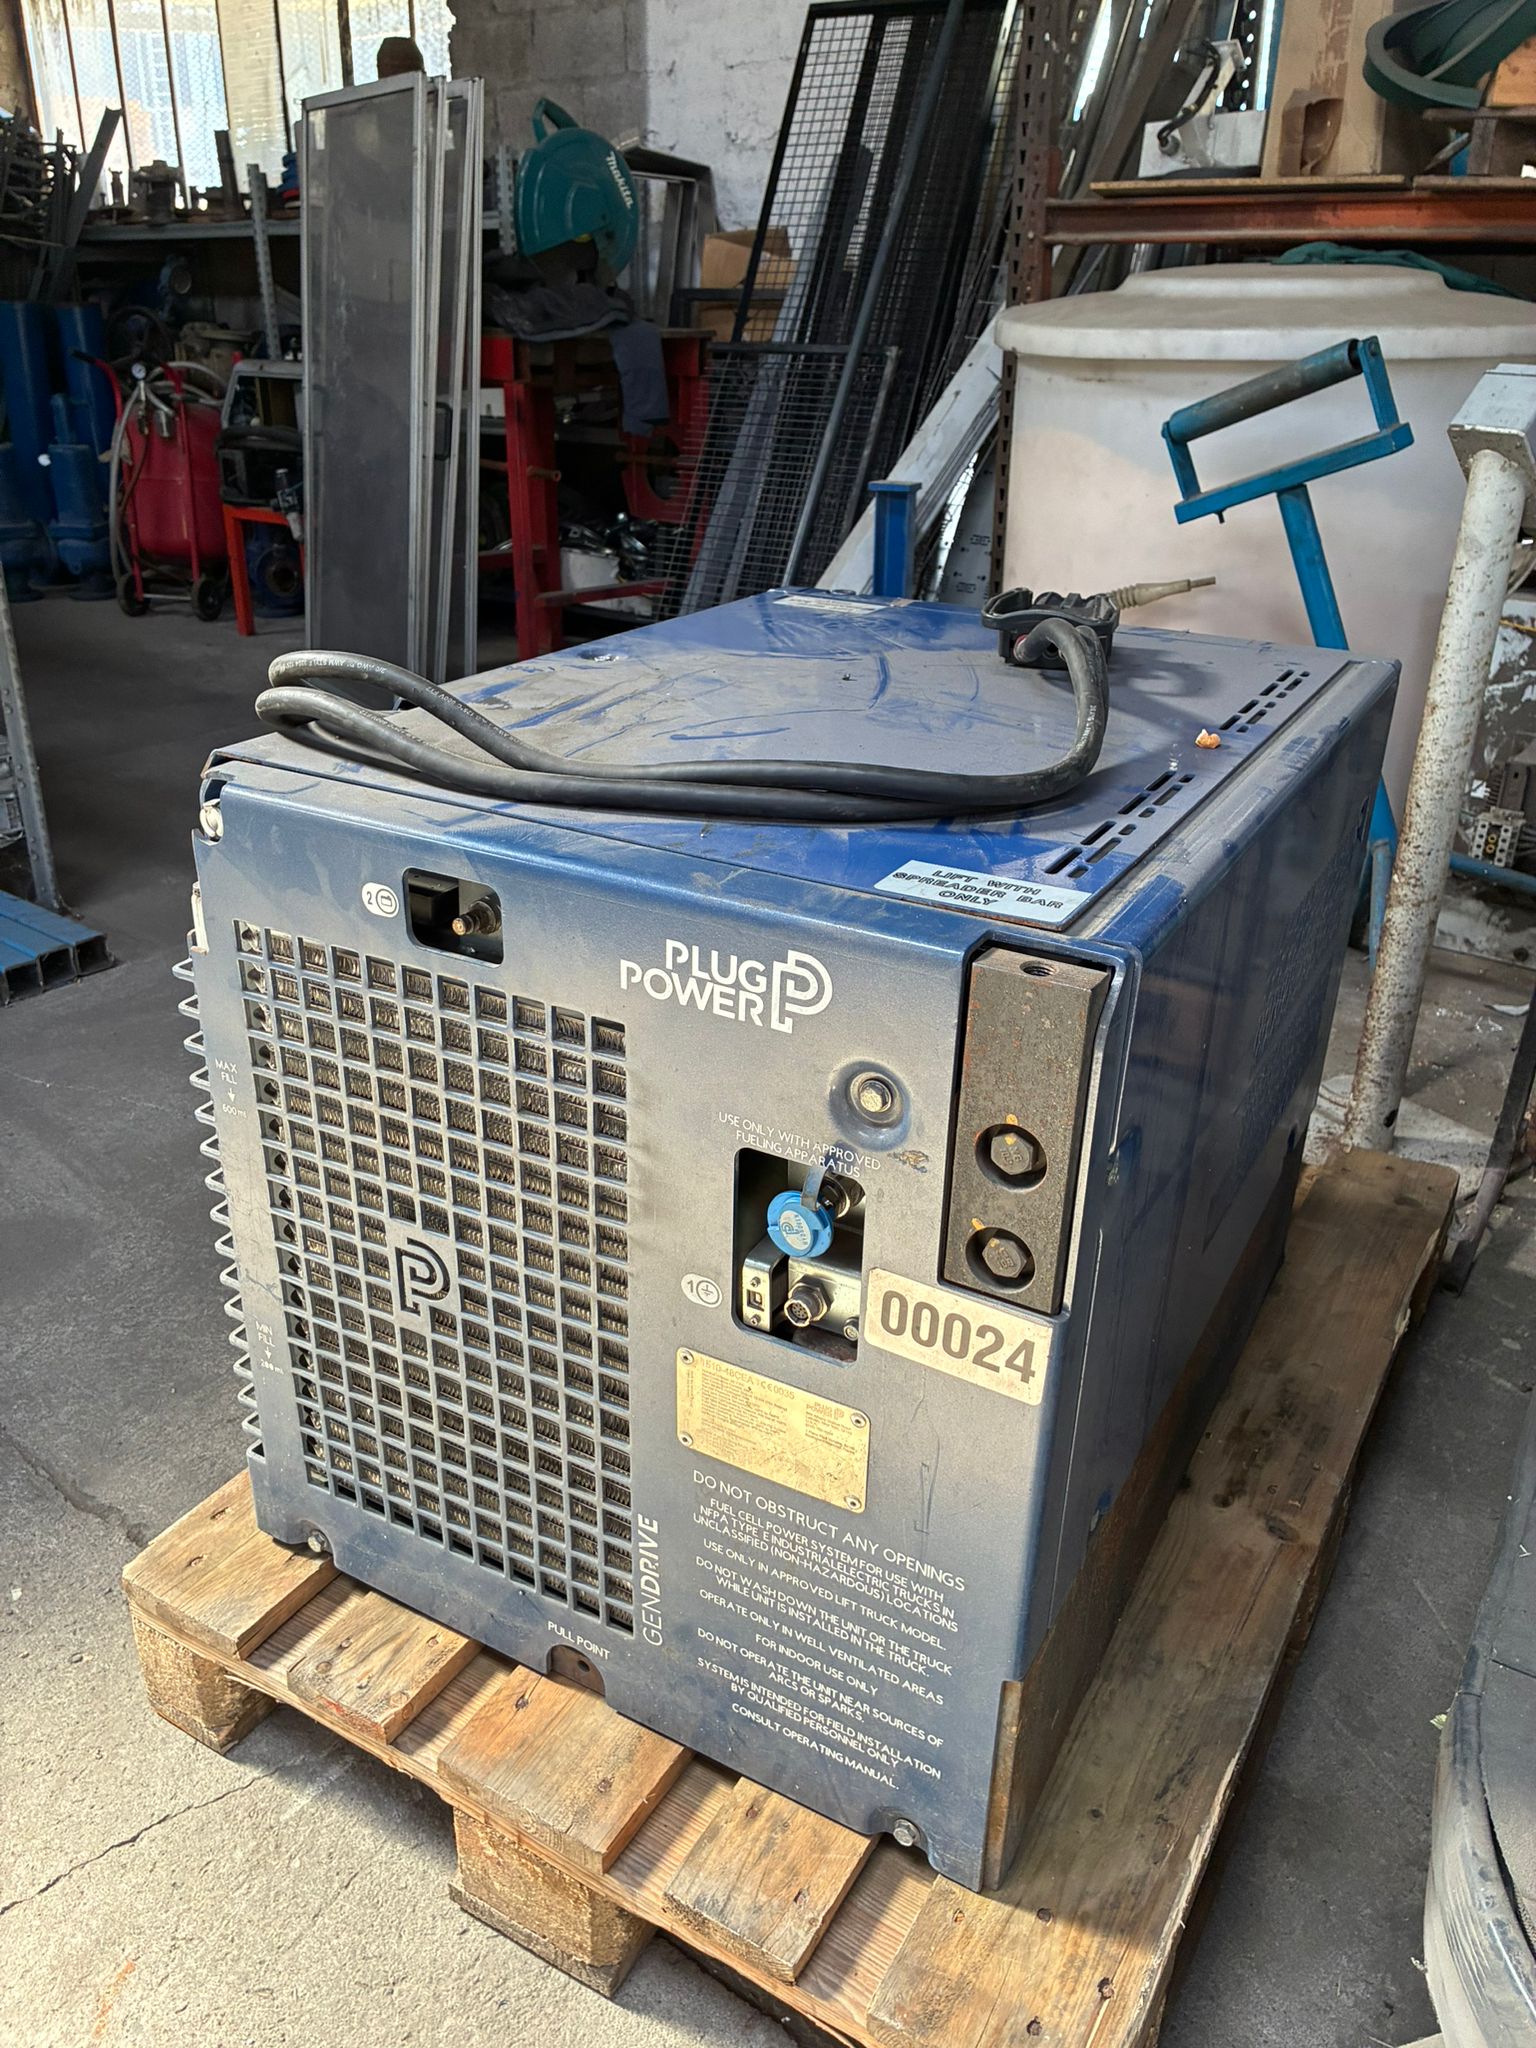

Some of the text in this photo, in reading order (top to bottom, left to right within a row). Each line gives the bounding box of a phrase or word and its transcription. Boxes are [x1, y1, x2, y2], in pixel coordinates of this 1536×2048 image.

[606, 150, 634, 209] Makita
[366, 890, 373, 905] 2
[892, 872, 1064, 908] SPREADER BAR
[932, 870, 1042, 895] LIFT WITH
[938, 890, 999, 906] ONLY
[620, 958, 764, 1027] POWER
[665, 938, 767, 994] PLUG
[215, 1058, 238, 1074] MAX
[221, 1072, 238, 1085] FILL
[718, 1112, 881, 1170] USE ONLY WITH APPROVED
[736, 1130, 860, 1178] FUELING APPARATUS
[687, 1280, 694, 1293] 1
[256, 1320, 272, 1336] MIN
[258, 1332, 276, 1348] FILL
[880, 1290, 1036, 1384] 00024
[694, 1470, 966, 1592] DO NOT OBSTRUCT ANY OPENINGS
[700, 1505, 728, 1524] NFPA
[731, 1518, 758, 1537] TYPE
[763, 1532, 769, 1542] E
[892, 1585, 940, 1613] TRUCKS
[942, 1606, 954, 1619] IN
[710, 1498, 944, 1602] FUEL CELL POWER SYSTEM FOR USE WITH
[638, 1513, 664, 1646] GENDRIVE
[694, 1512, 958, 1632] UNCLASSIFIED (NON-HAZARDOUS) LOCATIONS
[704, 1538, 947, 1650] USE ONLY IN APPROVED LIFT TRUCK MODEL.
[548, 1620, 611, 1660] PULL POINT
[696, 1556, 953, 1676] DO NOT WASH DOWN THE UNIT OR THE TRUCK
[716, 1575, 930, 1678] WHILE UNIT IS INSTALLED IN THE TRUCK.
[699, 1589, 944, 1706] OPERATE ONLY IN WELL VENTILATED AREAS
[756, 1634, 878, 1696] FOR INDOOR USE ONLY
[698, 1628, 944, 1748] DO NOT OPERATE THE UNIT NEAR SOURCES OF
[698, 1657, 941, 1780] SYSTEM IS INTENDED FOR FIELD INSTALLATION
[768, 1672, 865, 1723] ARCS OR SPARKS.
[731, 1682, 899, 1768] BY QUALIFIED PERSONNEL ONLY
[732, 1702, 900, 1790] CONSULT OPERATING MANUAL.
